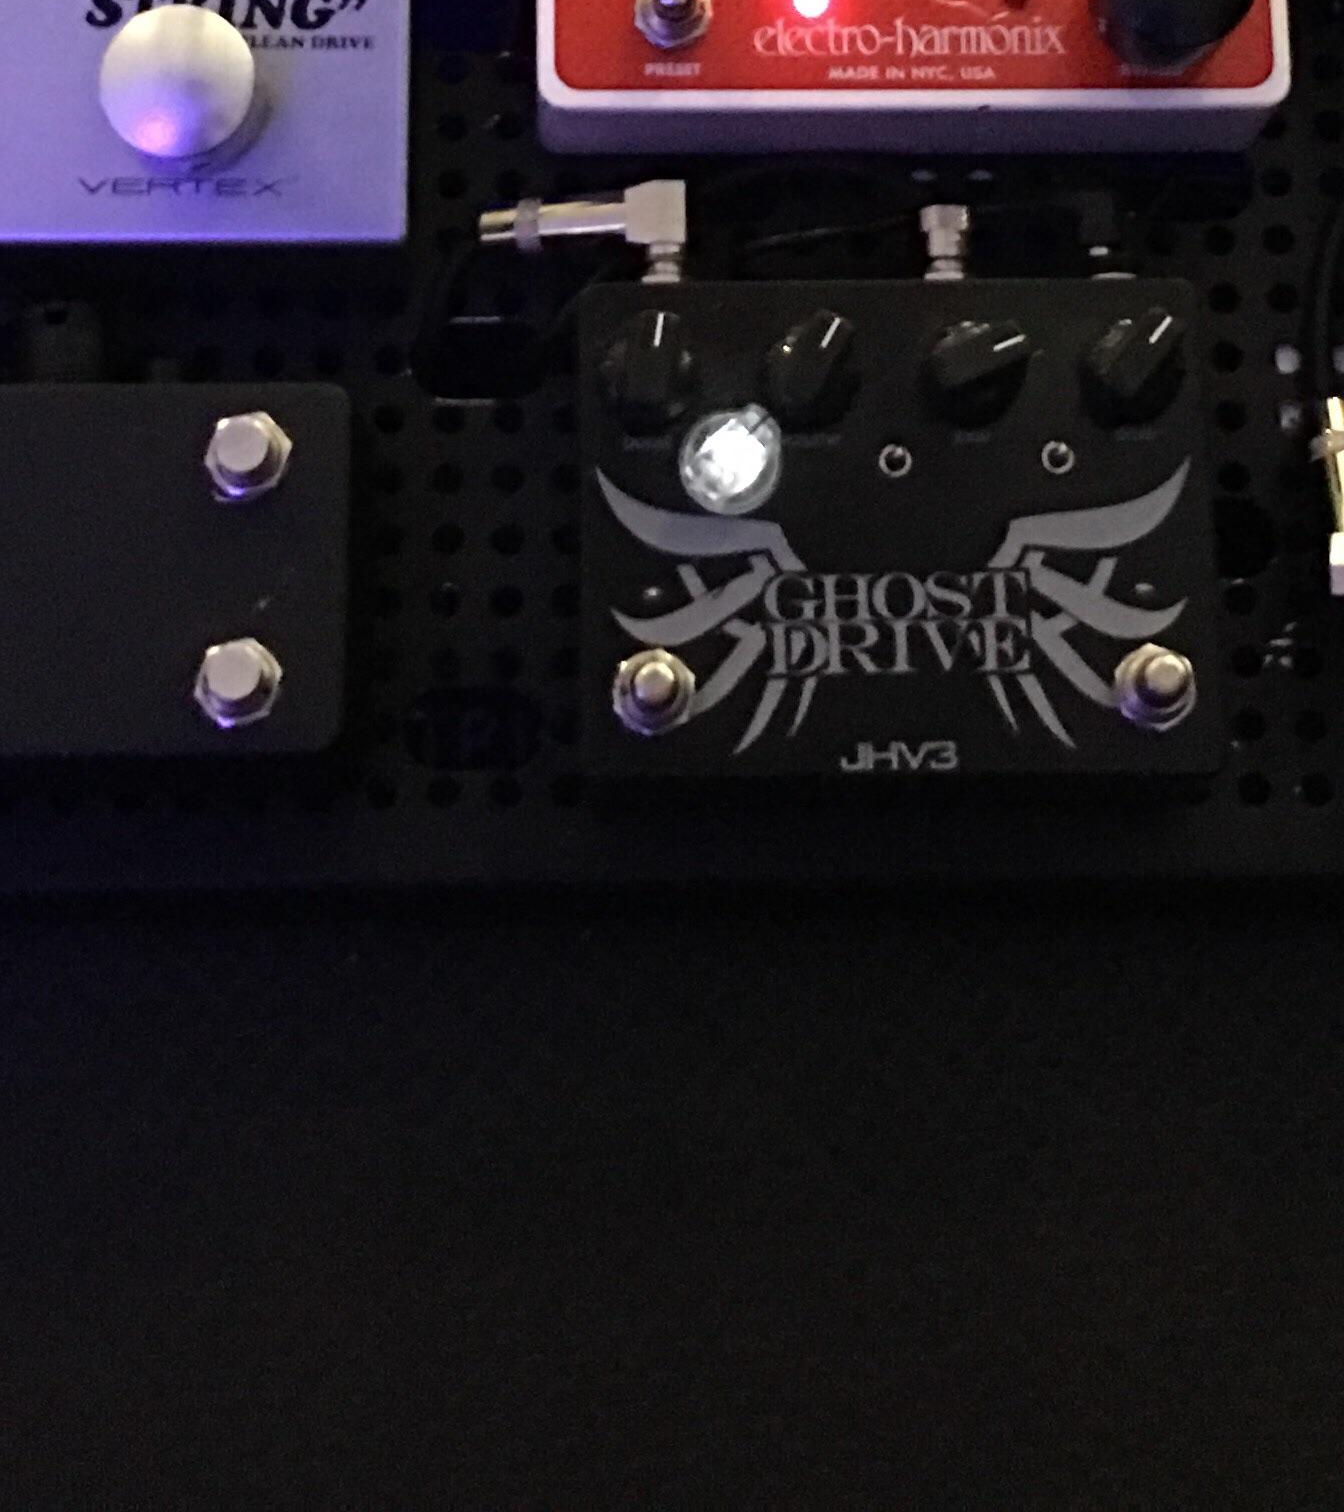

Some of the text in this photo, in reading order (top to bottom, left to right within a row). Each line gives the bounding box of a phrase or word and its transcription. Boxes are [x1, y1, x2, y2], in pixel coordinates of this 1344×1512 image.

[248, 35, 376, 51] LEAN DRIVE
[753, 16, 1067, 58] electro-harmonix
[828, 65, 879, 80] MADE
[885, 65, 905, 80] IN
[959, 65, 997, 80] USA
[77, 175, 284, 198] VERTEX
[763, 570, 1029, 621] GHOST
[766, 618, 1031, 675] DRIVE
[839, 740, 959, 770] JHV3
